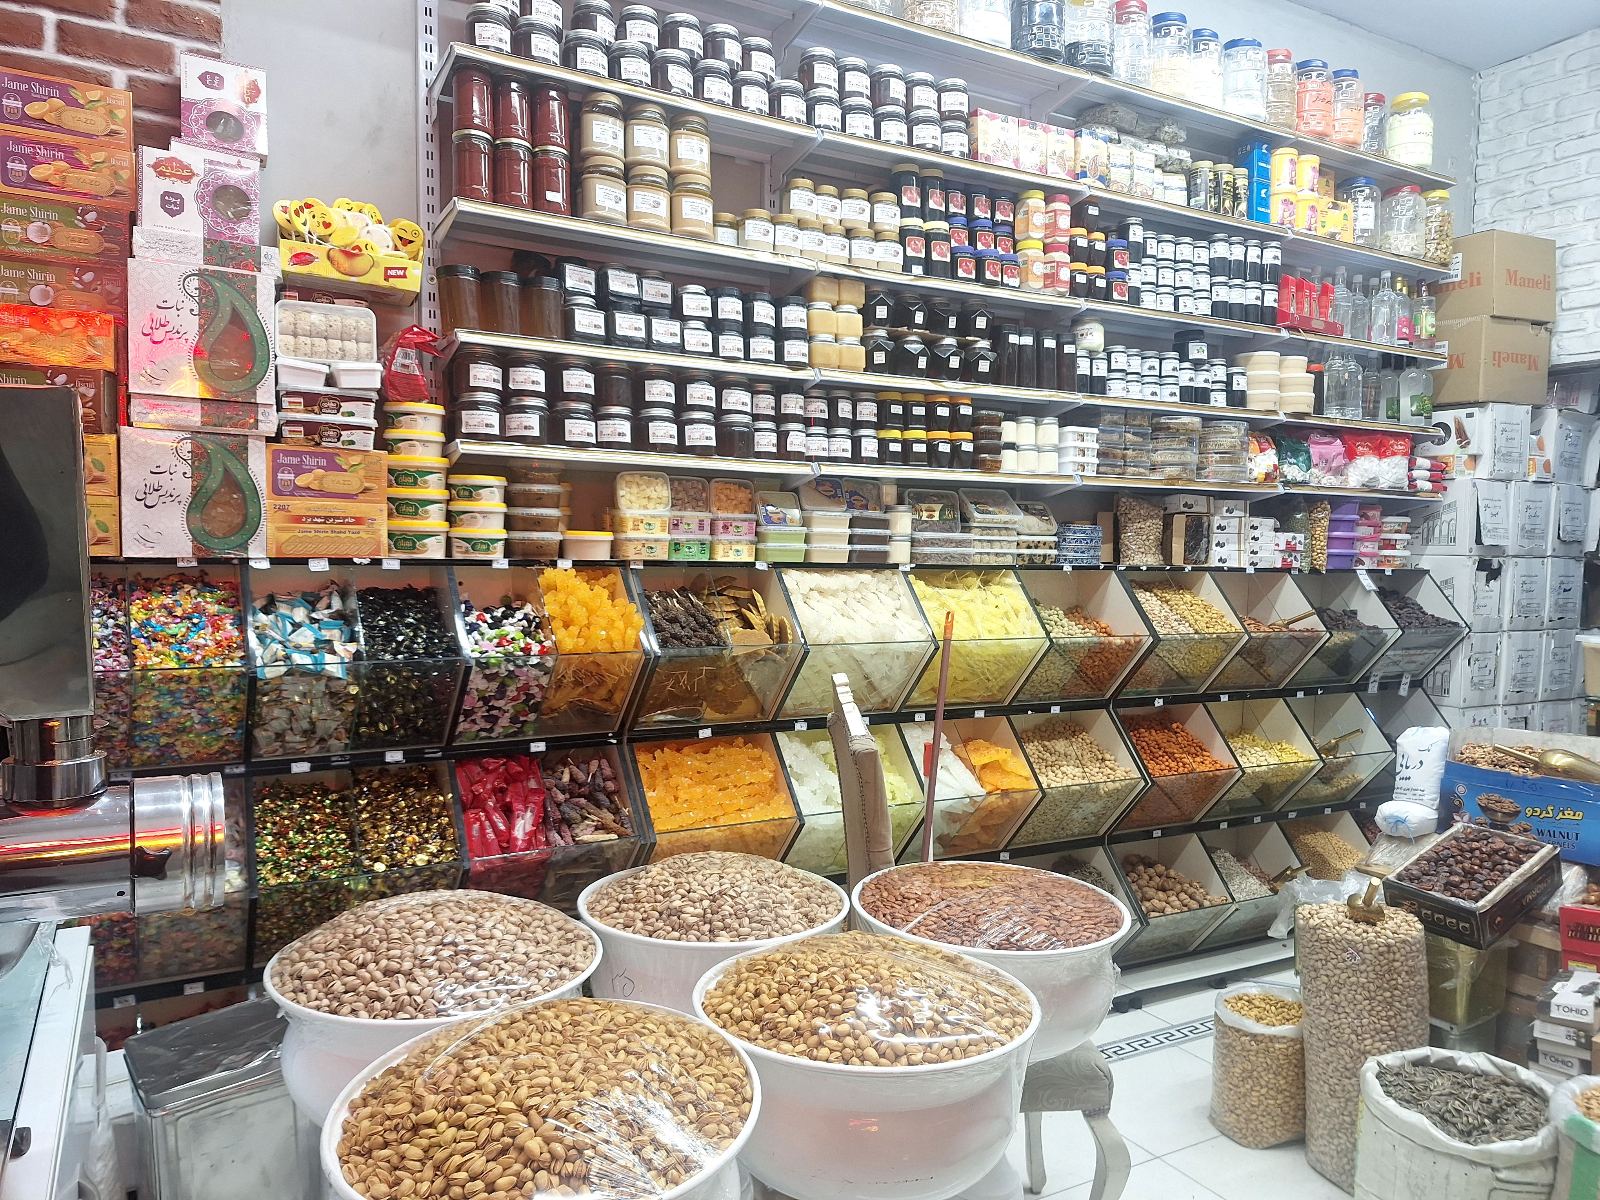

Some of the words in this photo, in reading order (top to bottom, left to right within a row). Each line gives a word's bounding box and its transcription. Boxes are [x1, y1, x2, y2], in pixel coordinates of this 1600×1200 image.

[2, 77, 29, 92] Jame
[31, 82, 60, 97] Shirin
[7, 141, 34, 155] Jame
[36, 145, 65, 160] Shirin
[0, 203, 28, 216] Jame
[30, 206, 59, 220] Shirin
[0, 265, 25, 279] Jame
[27, 269, 56, 282] Shirin
[1505, 268, 1552, 291] Maneli
[156, 300, 185, 317] نبات
[1492, 351, 1540, 372] Maneli
[277, 453, 301, 465] Jame
[302, 454, 327, 466] Shirin
[149, 463, 178, 481] نبات
[273, 503, 291, 511] 2207
[1525, 804, 1554, 819] گردو
[1555, 807, 1584, 821] مغز
[1536, 828, 1580, 841] WALNUT
[1540, 839, 1576, 850] ERNELS
